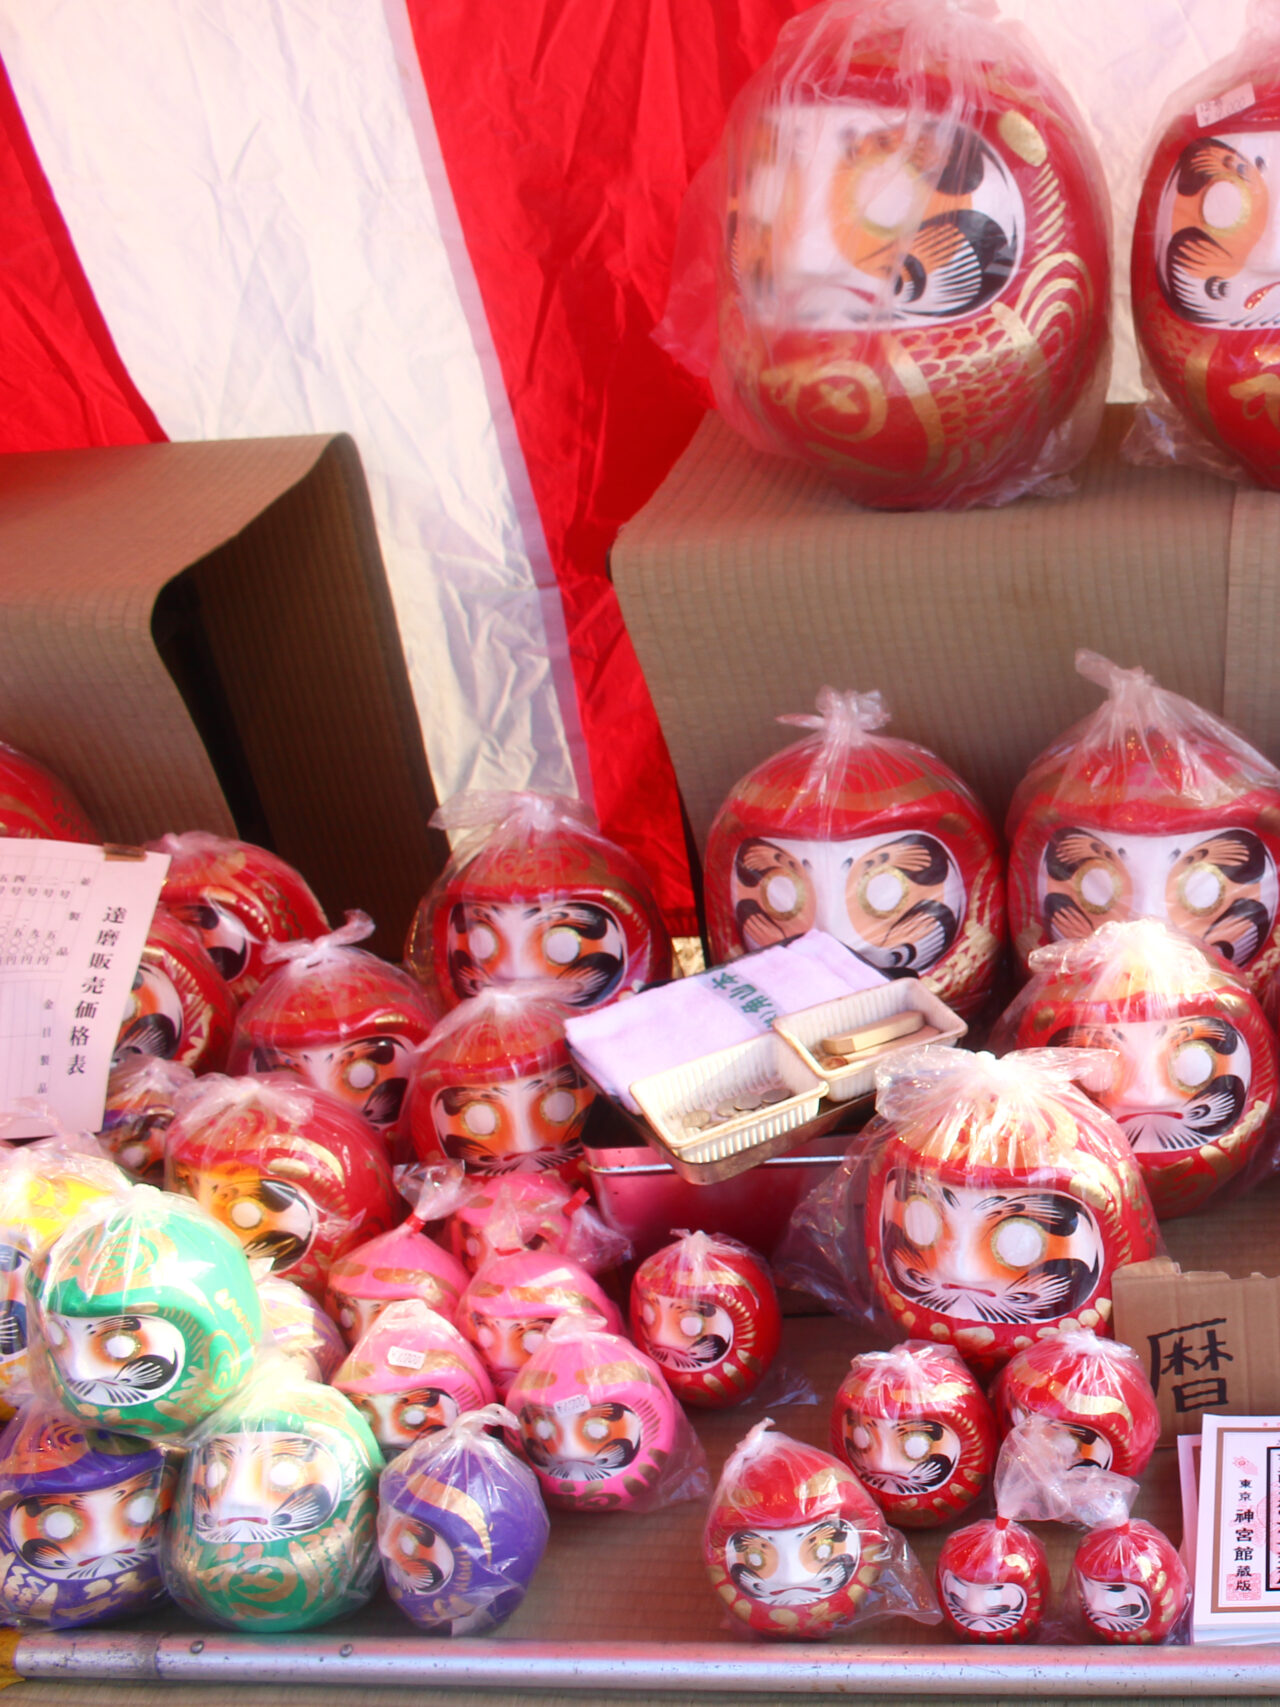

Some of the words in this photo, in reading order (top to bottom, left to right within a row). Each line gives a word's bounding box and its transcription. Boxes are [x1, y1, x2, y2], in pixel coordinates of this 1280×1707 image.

[67, 905, 127, 1076] 達磨販売価格表
[1147, 1318, 1233, 1412] 暦
